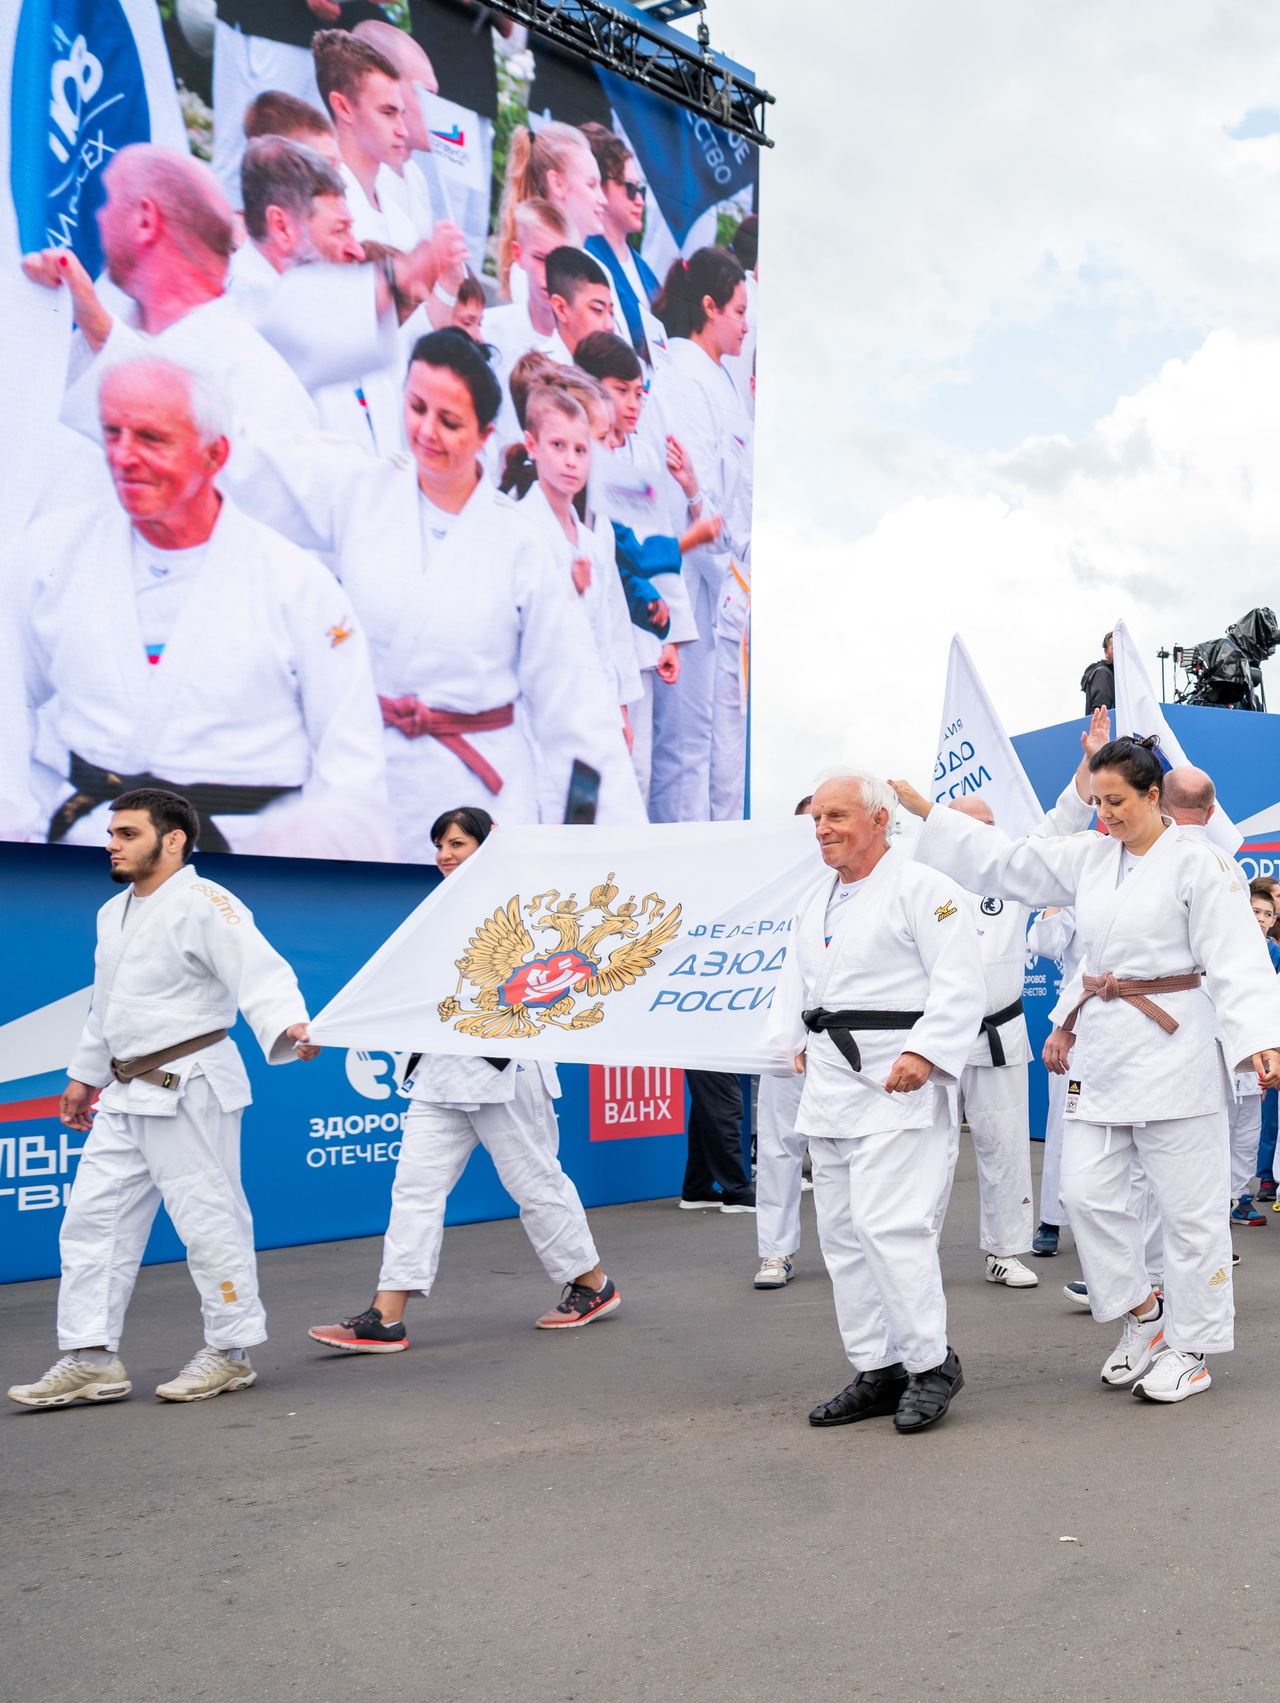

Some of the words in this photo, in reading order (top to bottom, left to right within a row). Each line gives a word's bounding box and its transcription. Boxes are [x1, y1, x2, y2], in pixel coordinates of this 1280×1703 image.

[668, 946, 787, 977] ДЗЮД
[604, 1098, 672, 1124] ВДНХ
[309, 1112, 408, 1140] ЗДОРО
